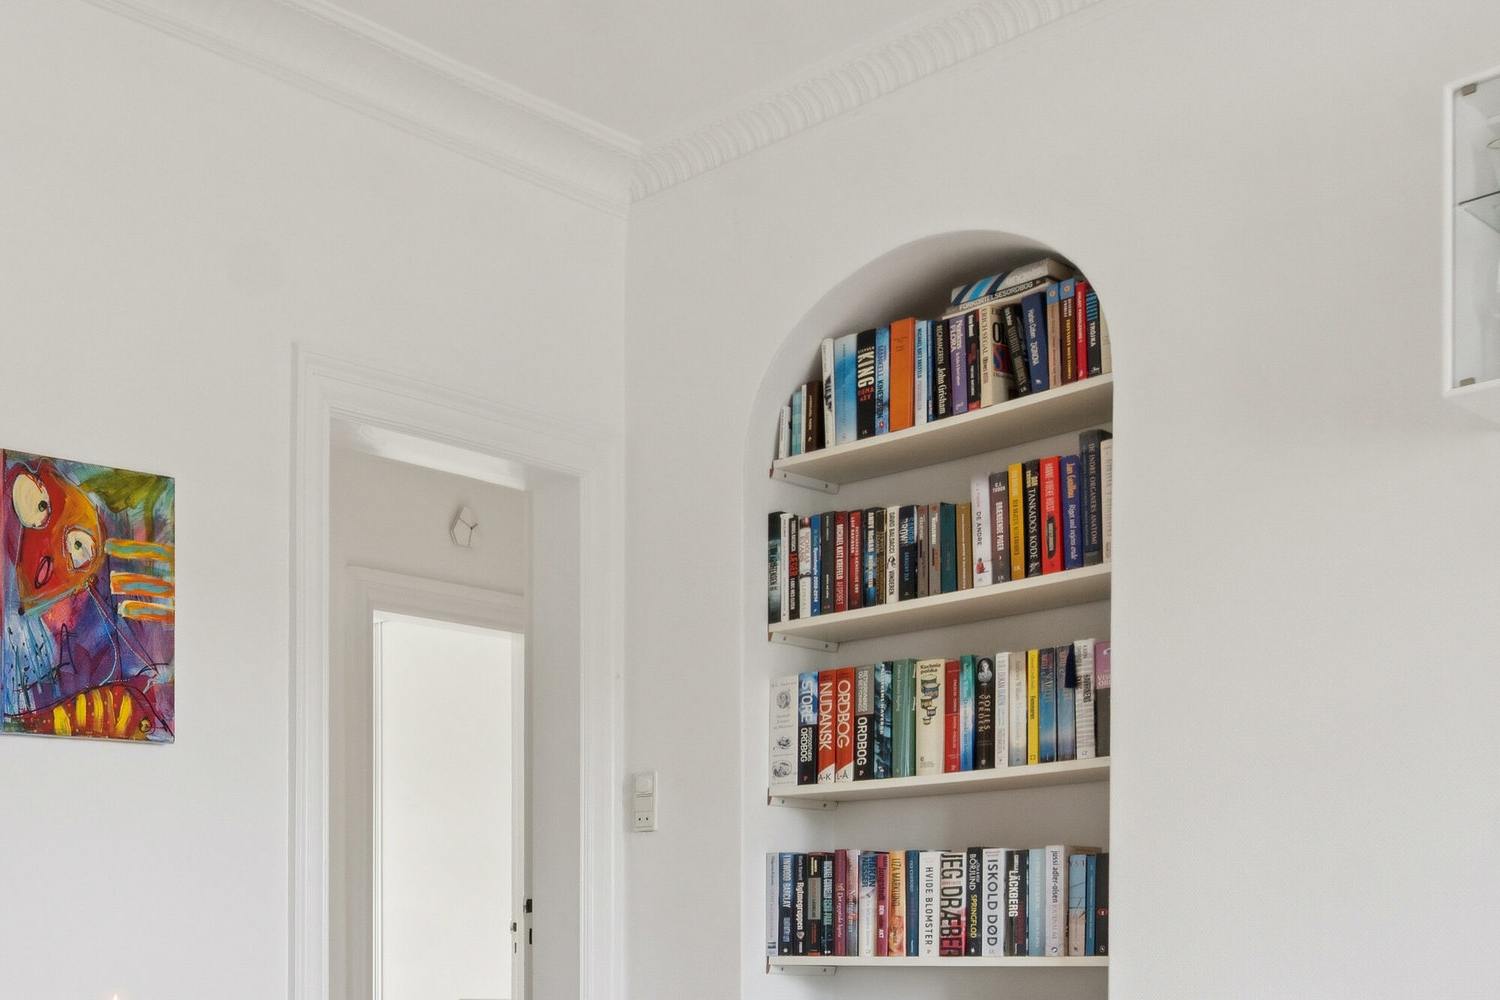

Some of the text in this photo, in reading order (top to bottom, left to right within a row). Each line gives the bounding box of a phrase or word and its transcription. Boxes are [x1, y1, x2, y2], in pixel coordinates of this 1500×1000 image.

[956, 319, 964, 350] Nordens
[981, 308, 990, 355] ERICH SEGAL
[858, 351, 875, 388] KING
[937, 367, 948, 415] John Grisham
[1088, 476, 1097, 513] ORGANERS
[1028, 488, 1038, 560] TANKADOS KODE
[800, 680, 813, 723] STORE
[819, 682, 833, 752] NUDANSK
[837, 680, 851, 749] ORDBOG
[800, 727, 808, 763] ORDBOG
[856, 717, 868, 766] ORDBOG
[782, 855, 791, 881] LINWOOD
[861, 856, 869, 888] NESSER
[891, 858, 902, 907] LIZA MARKLUND
[1050, 850, 1060, 904] jussi adler-olsen
[782, 881, 791, 908] BARCLAY
[925, 866, 934, 945] HVIDE BLOMSTER
[940, 853, 964, 956] JEG DRÆBER
[970, 893, 978, 939] SPRINGFLOD
[987, 859, 999, 947] ISKOLD DØD
[1008, 870, 1020, 918] LÄCKBERG
